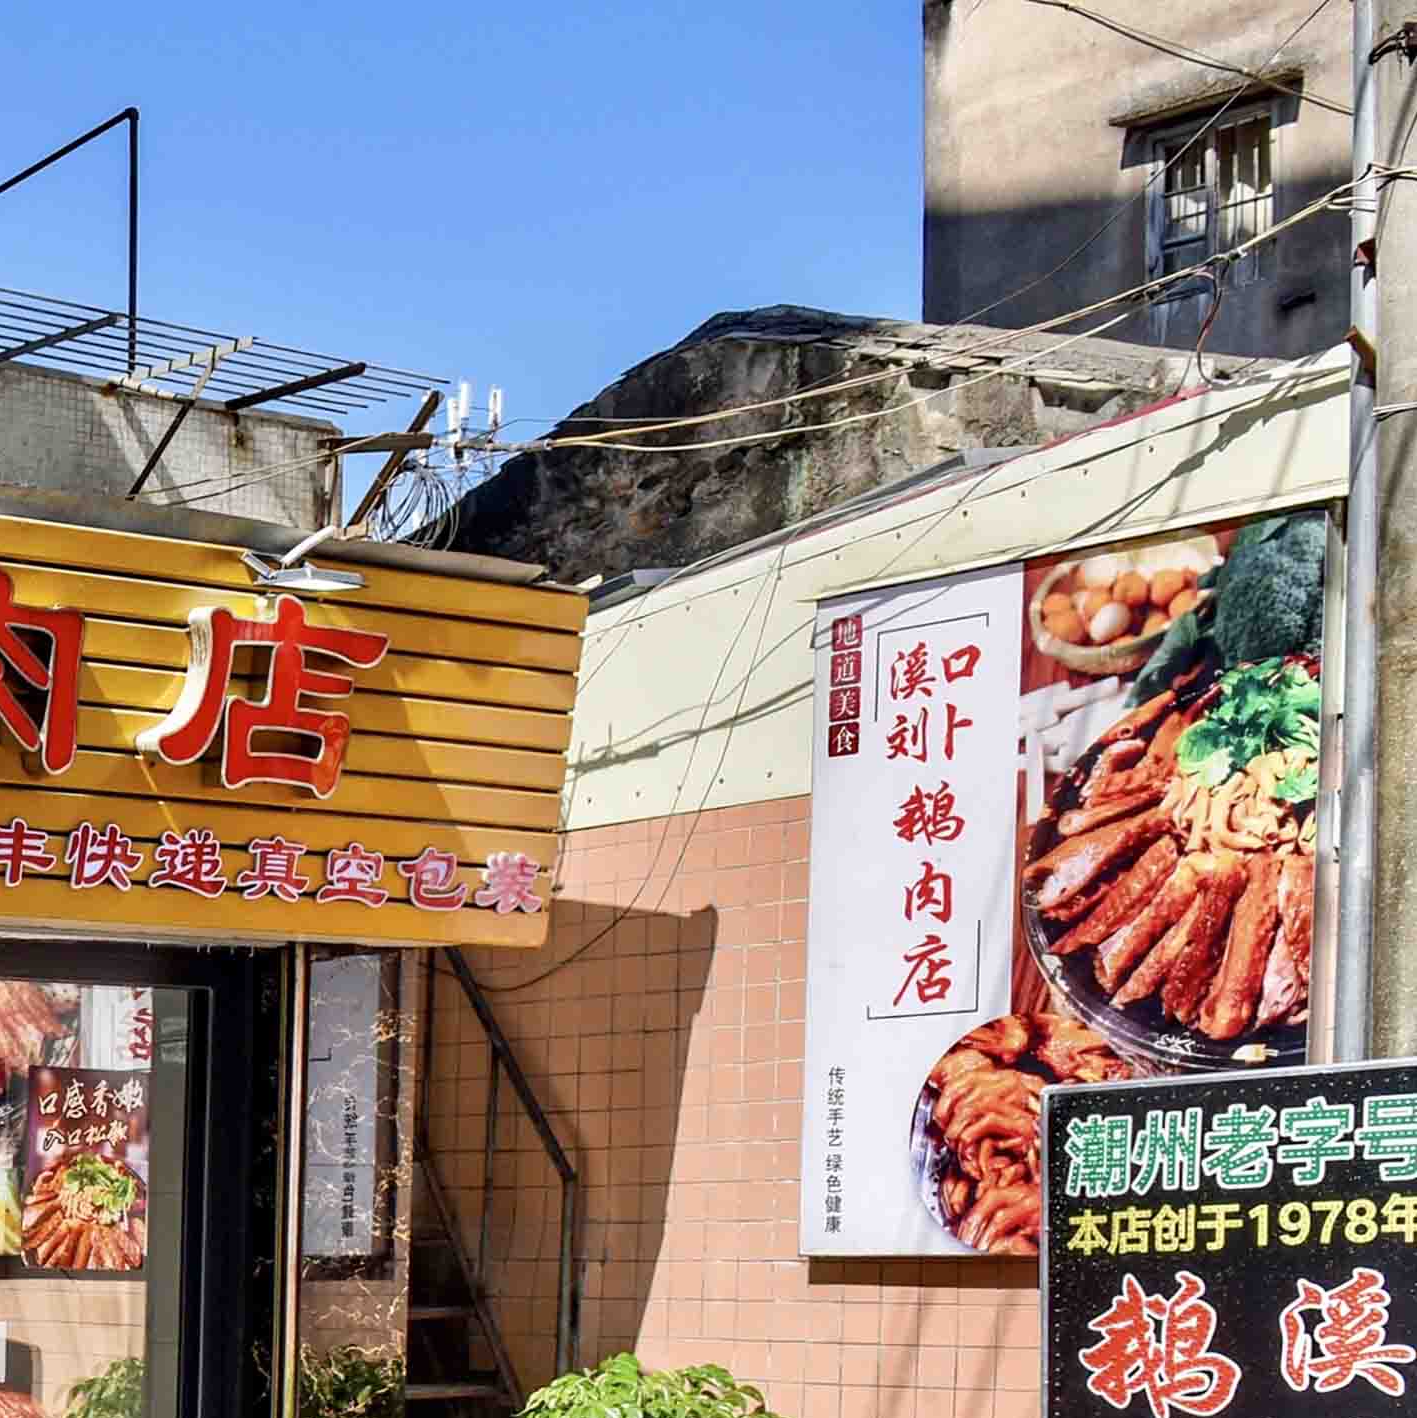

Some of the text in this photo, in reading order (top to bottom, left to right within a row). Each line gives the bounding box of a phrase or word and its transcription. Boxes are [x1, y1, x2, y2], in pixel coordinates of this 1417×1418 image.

[829, 614, 862, 757] 地道美食
[824, 1064, 845, 1234] 传统手艺 绿色健康
[1065, 1093, 1417, 1198] 潮州老字号
[1067, 1192, 1417, 1257] 本店创于1978年
